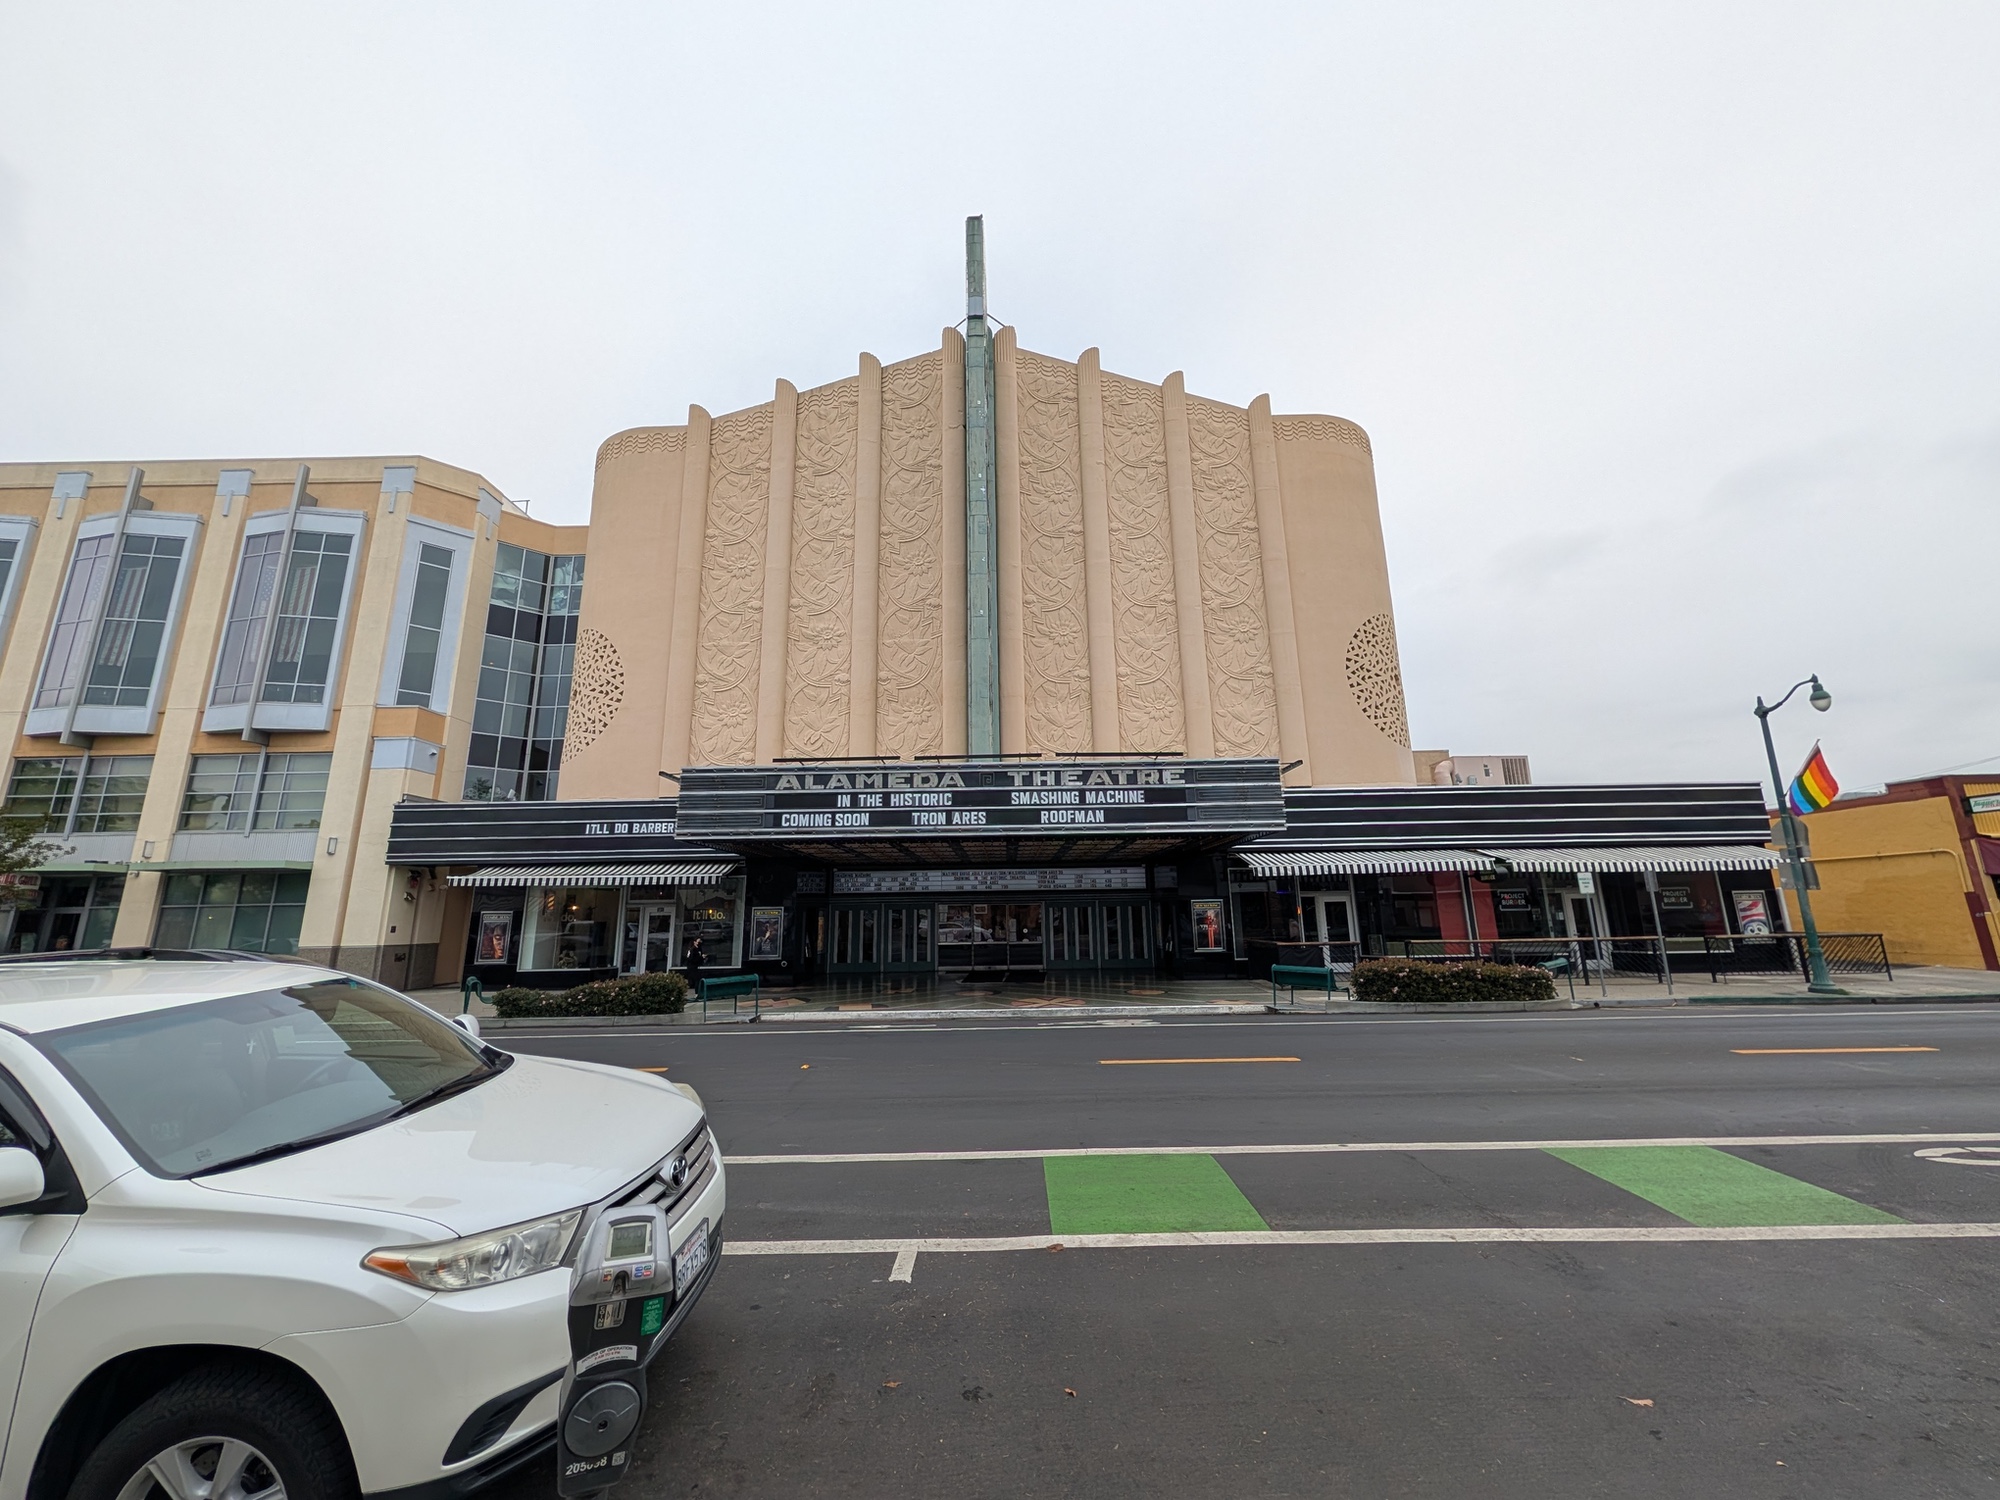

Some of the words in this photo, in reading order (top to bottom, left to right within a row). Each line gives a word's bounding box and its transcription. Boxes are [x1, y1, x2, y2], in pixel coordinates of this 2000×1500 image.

[775, 772, 966, 790] ALAMEDA
[1007, 769, 1186, 787] THEATRE
[837, 794, 850, 808] IN
[858, 794, 883, 807] THE
[890, 792, 952, 807] HISTORIC
[1011, 791, 1080, 805] SMASHING
[1085, 790, 1145, 804] MACHINE
[781, 813, 832, 827] COMING
[835, 813, 870, 826] SOON
[912, 812, 946, 825] TRON
[951, 811, 987, 825] ARES
[1040, 810, 1104, 824] ROOFMAN
[585, 823, 610, 835] ITLL
[614, 823, 628, 834] DO
[693, 909, 708, 920] It'll
[709, 909, 726, 920] do.
